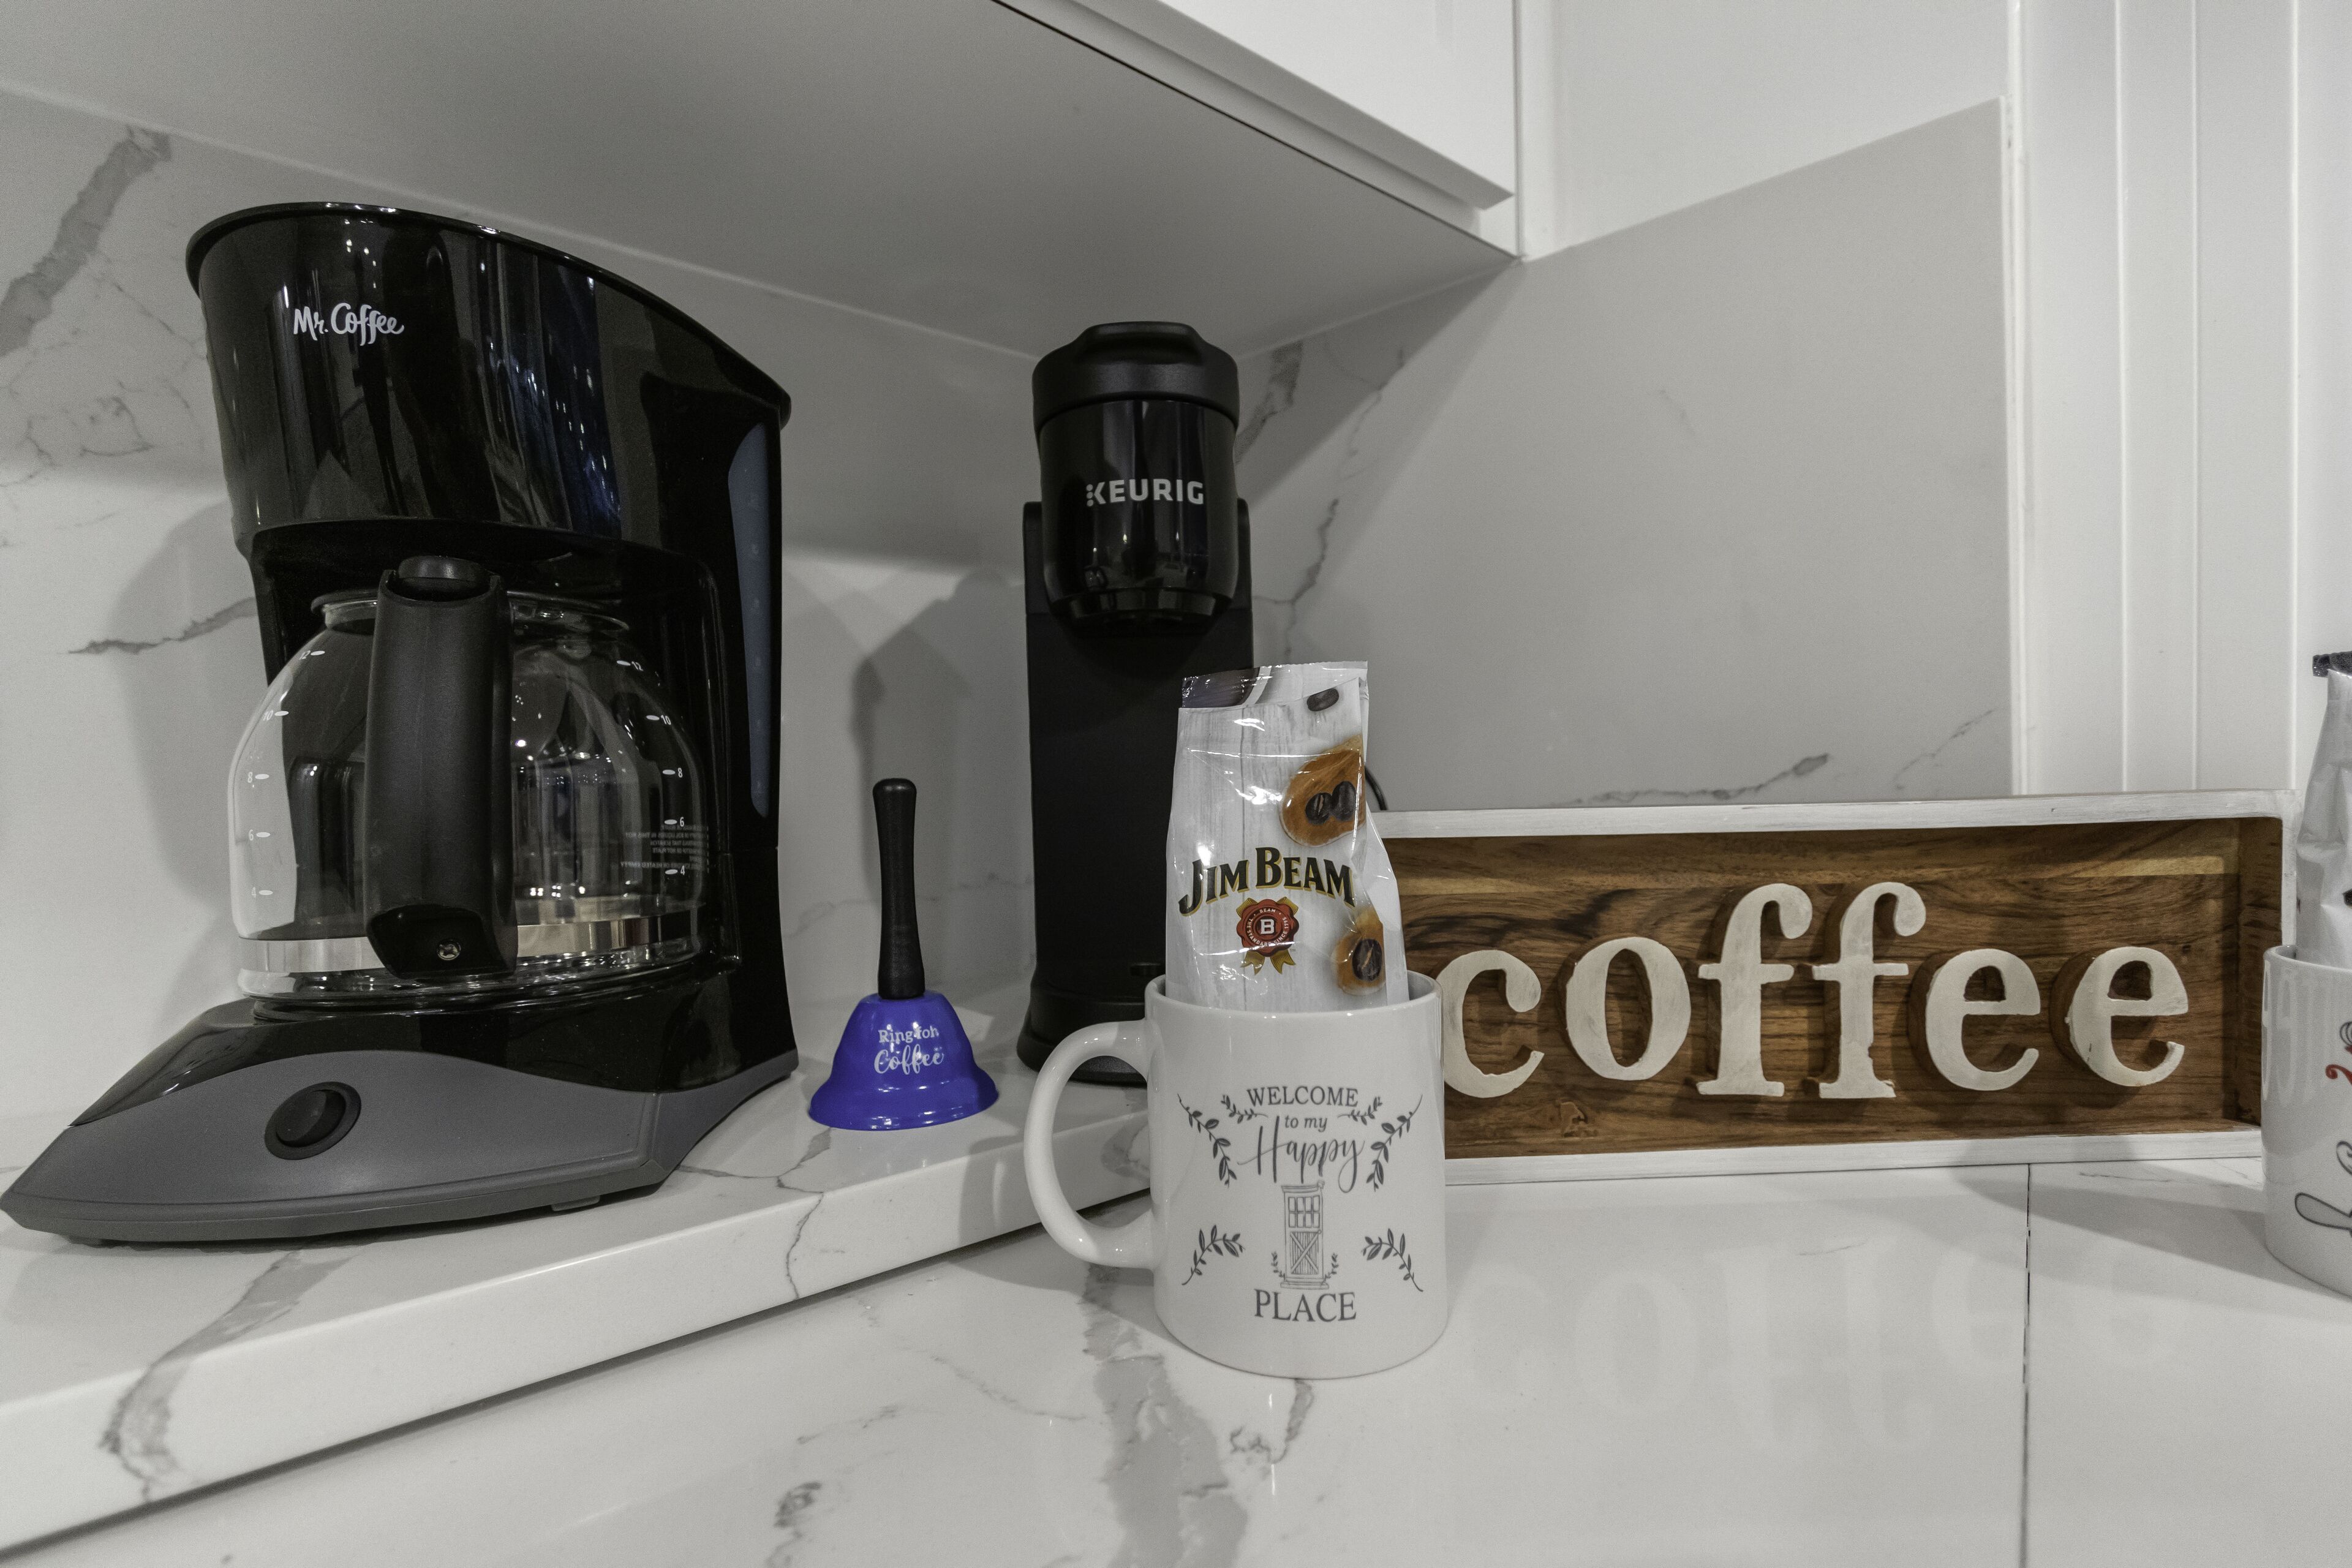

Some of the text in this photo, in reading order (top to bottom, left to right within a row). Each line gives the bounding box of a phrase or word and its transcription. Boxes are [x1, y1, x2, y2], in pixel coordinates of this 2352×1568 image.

[293, 303, 404, 346] Mr. Coffee
[1086, 478, 1204, 507] KEURIG
[631, 661, 644, 671] 12
[262, 710, 274, 721] 10
[660, 714, 671, 725] 10
[247, 771, 253, 783] 8
[677, 767, 683, 778] 8
[679, 816, 685, 827] 6
[249, 829, 254, 841] 6
[680, 865, 685, 875] 4
[1178, 846, 1355, 916] JIM BEAM
[251, 886, 257, 898] 4
[1260, 919, 1275, 935] B
[1436, 881, 2189, 1099] coffee
[874, 1044, 944, 1076] Coffee
[1246, 1085, 1359, 1107] WELCOME
[1285, 1116, 1328, 1133] to my
[1237, 1115, 1366, 1193] Happy
[1254, 1289, 1357, 1323] PLACE
